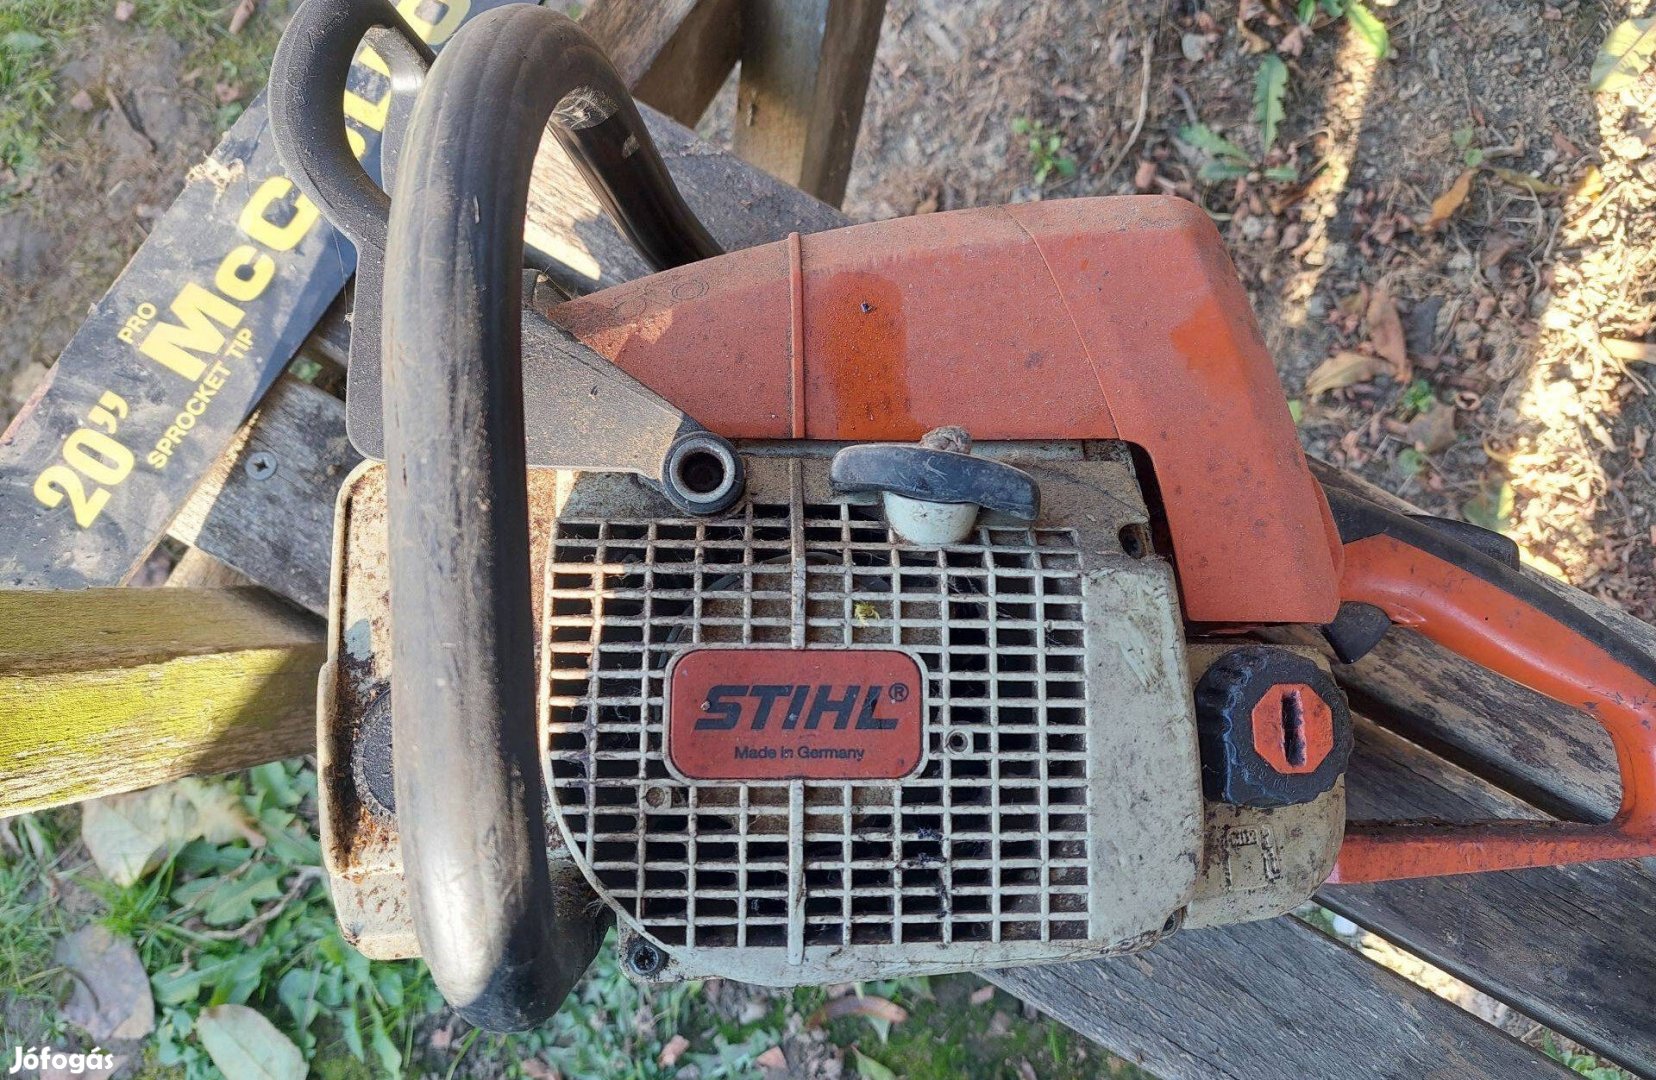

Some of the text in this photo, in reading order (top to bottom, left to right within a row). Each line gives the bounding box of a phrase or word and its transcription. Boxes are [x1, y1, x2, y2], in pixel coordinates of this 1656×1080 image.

[117, 302, 157, 346] PRO
[147, 327, 254, 469] SPROCKET TIP
[734, 745, 865, 762] Made in Germany
